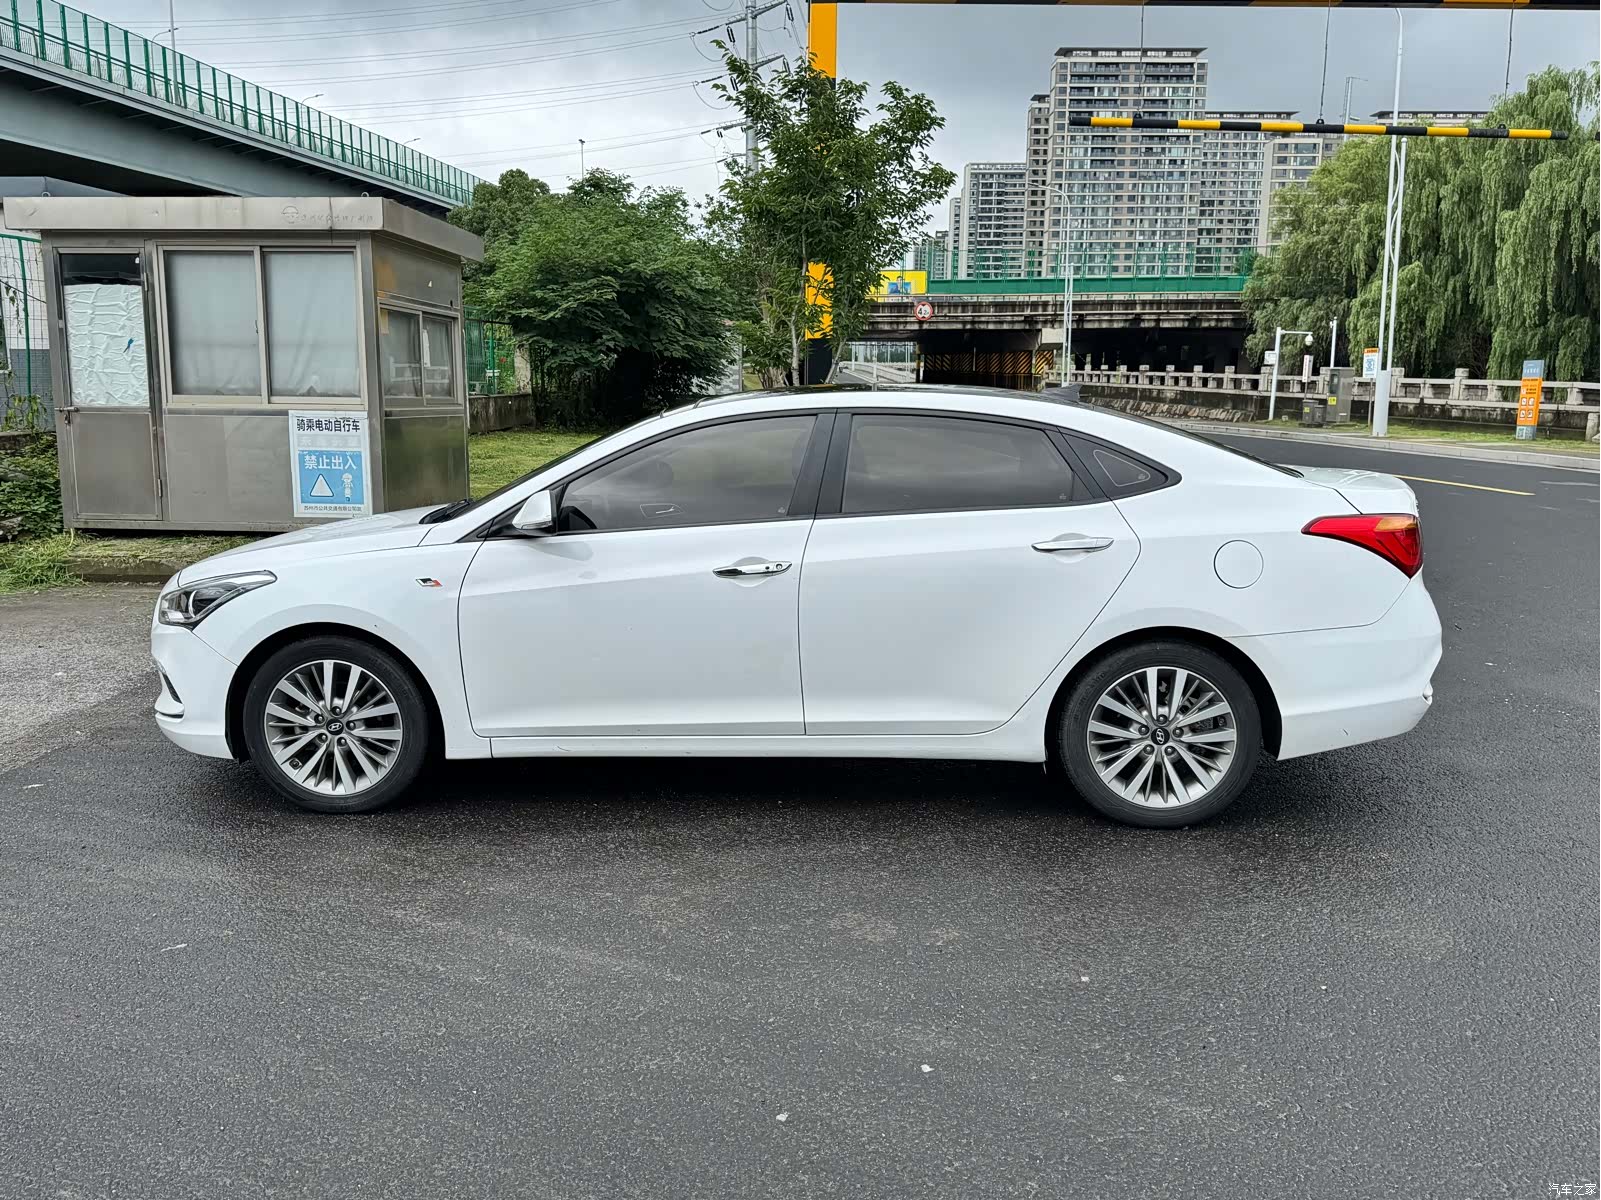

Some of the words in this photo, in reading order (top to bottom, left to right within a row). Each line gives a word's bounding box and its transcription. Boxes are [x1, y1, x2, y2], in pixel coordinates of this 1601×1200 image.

[296, 418, 361, 432] 骑乘电动自行车
[304, 454, 357, 470] 禁止出入
